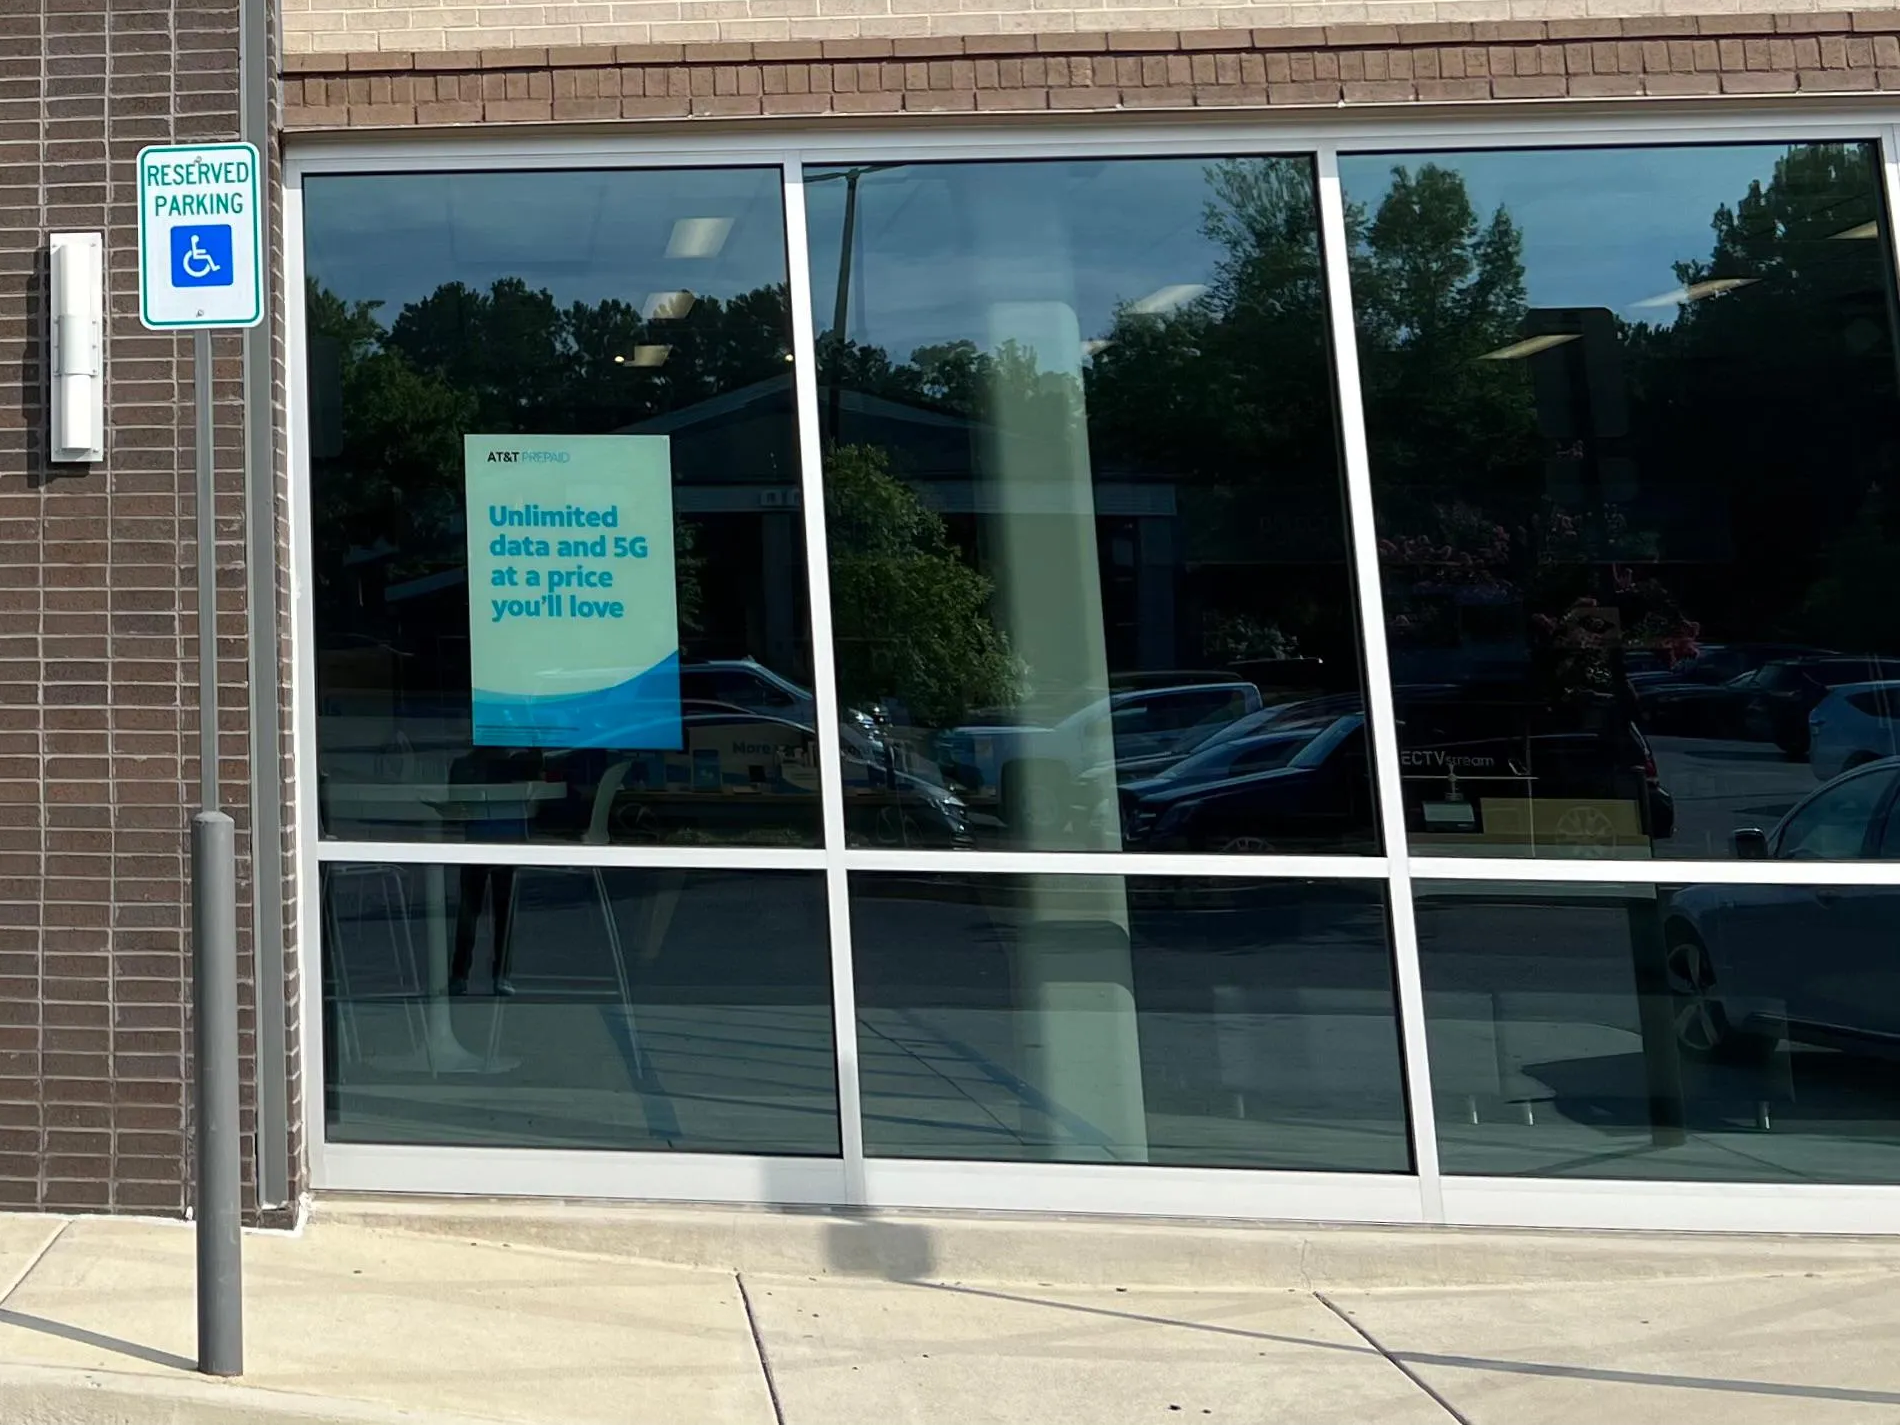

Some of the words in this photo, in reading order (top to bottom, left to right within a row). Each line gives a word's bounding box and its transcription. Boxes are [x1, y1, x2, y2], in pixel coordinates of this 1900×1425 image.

[147, 162, 249, 186] RESERVED
[155, 193, 243, 216] PARKING
[487, 451, 520, 463] AT&T
[522, 451, 570, 463] PREPAID
[489, 504, 618, 527] Unlimited
[489, 534, 550, 557] data
[557, 535, 607, 557] and
[613, 536, 648, 558] 5G
[491, 566, 519, 587] at
[525, 569, 541, 587] a
[547, 565, 613, 593] price
[491, 594, 562, 623] you'll
[570, 594, 624, 618] love
